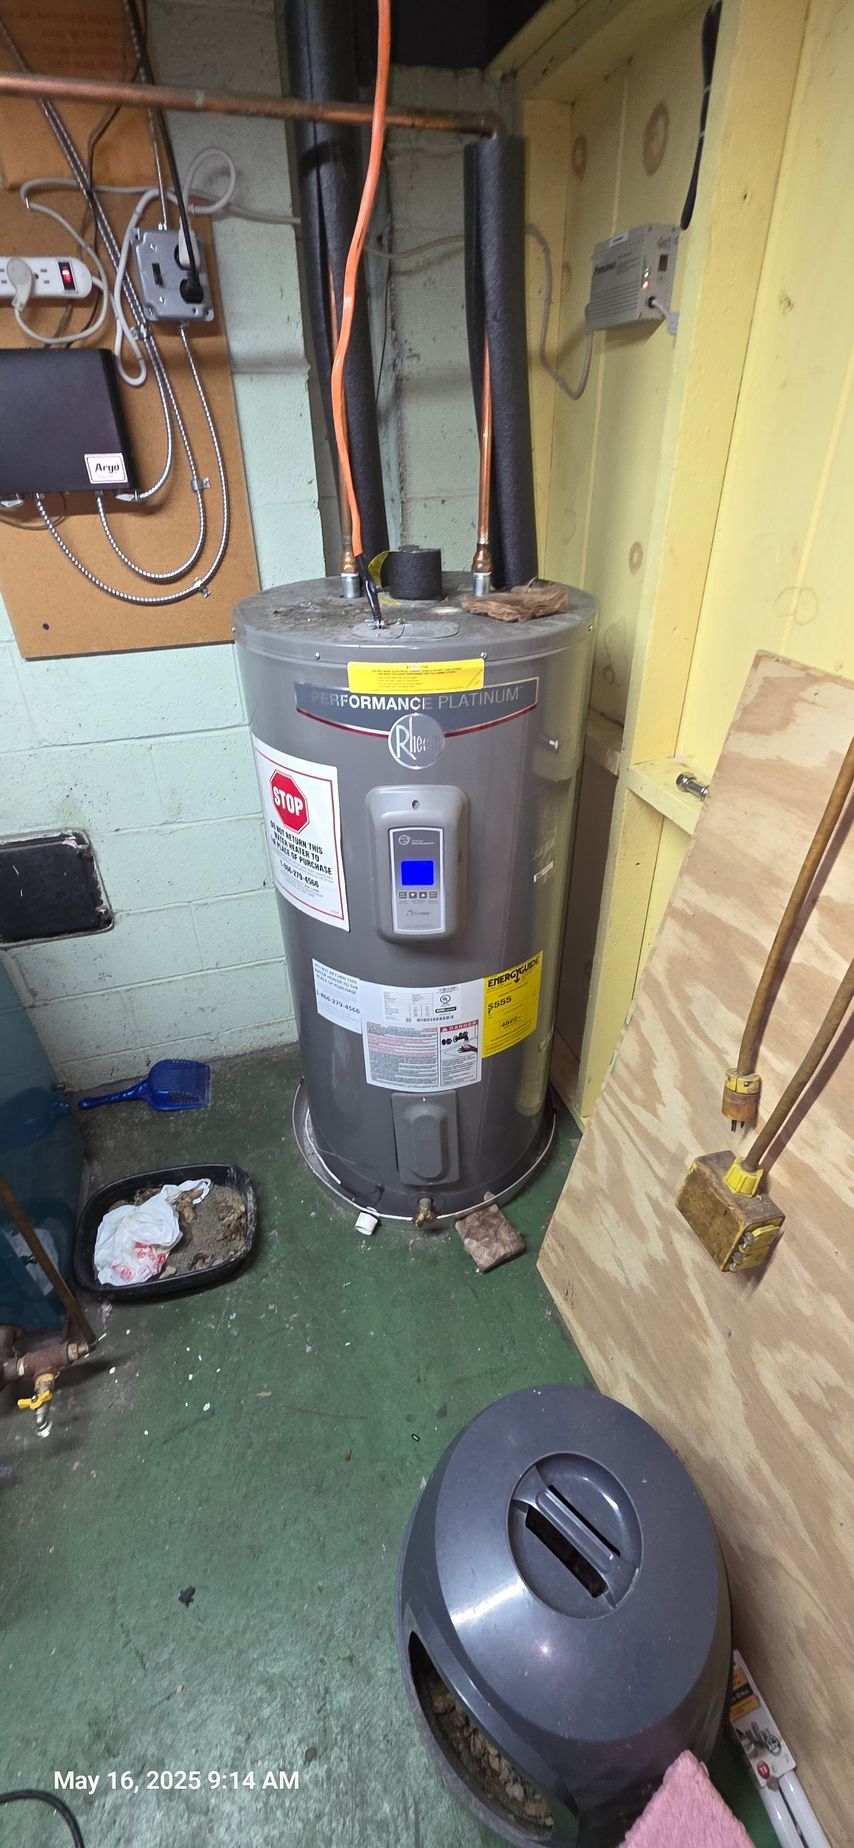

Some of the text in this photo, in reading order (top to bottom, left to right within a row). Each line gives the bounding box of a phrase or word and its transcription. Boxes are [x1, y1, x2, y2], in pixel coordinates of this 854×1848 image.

[95, 463, 120, 474] Argo
[312, 693, 433, 711] PERFORMANCE
[273, 786, 304, 816] STOP
[274, 831, 320, 862] WATER HEATER TO
[276, 825, 285, 837] NOT
[286, 831, 307, 849] RETURN
[308, 842, 323, 855] THIS
[277, 842, 291, 857] PLACE
[291, 851, 298, 861] OF
[299, 855, 333, 876] PURCHASE
